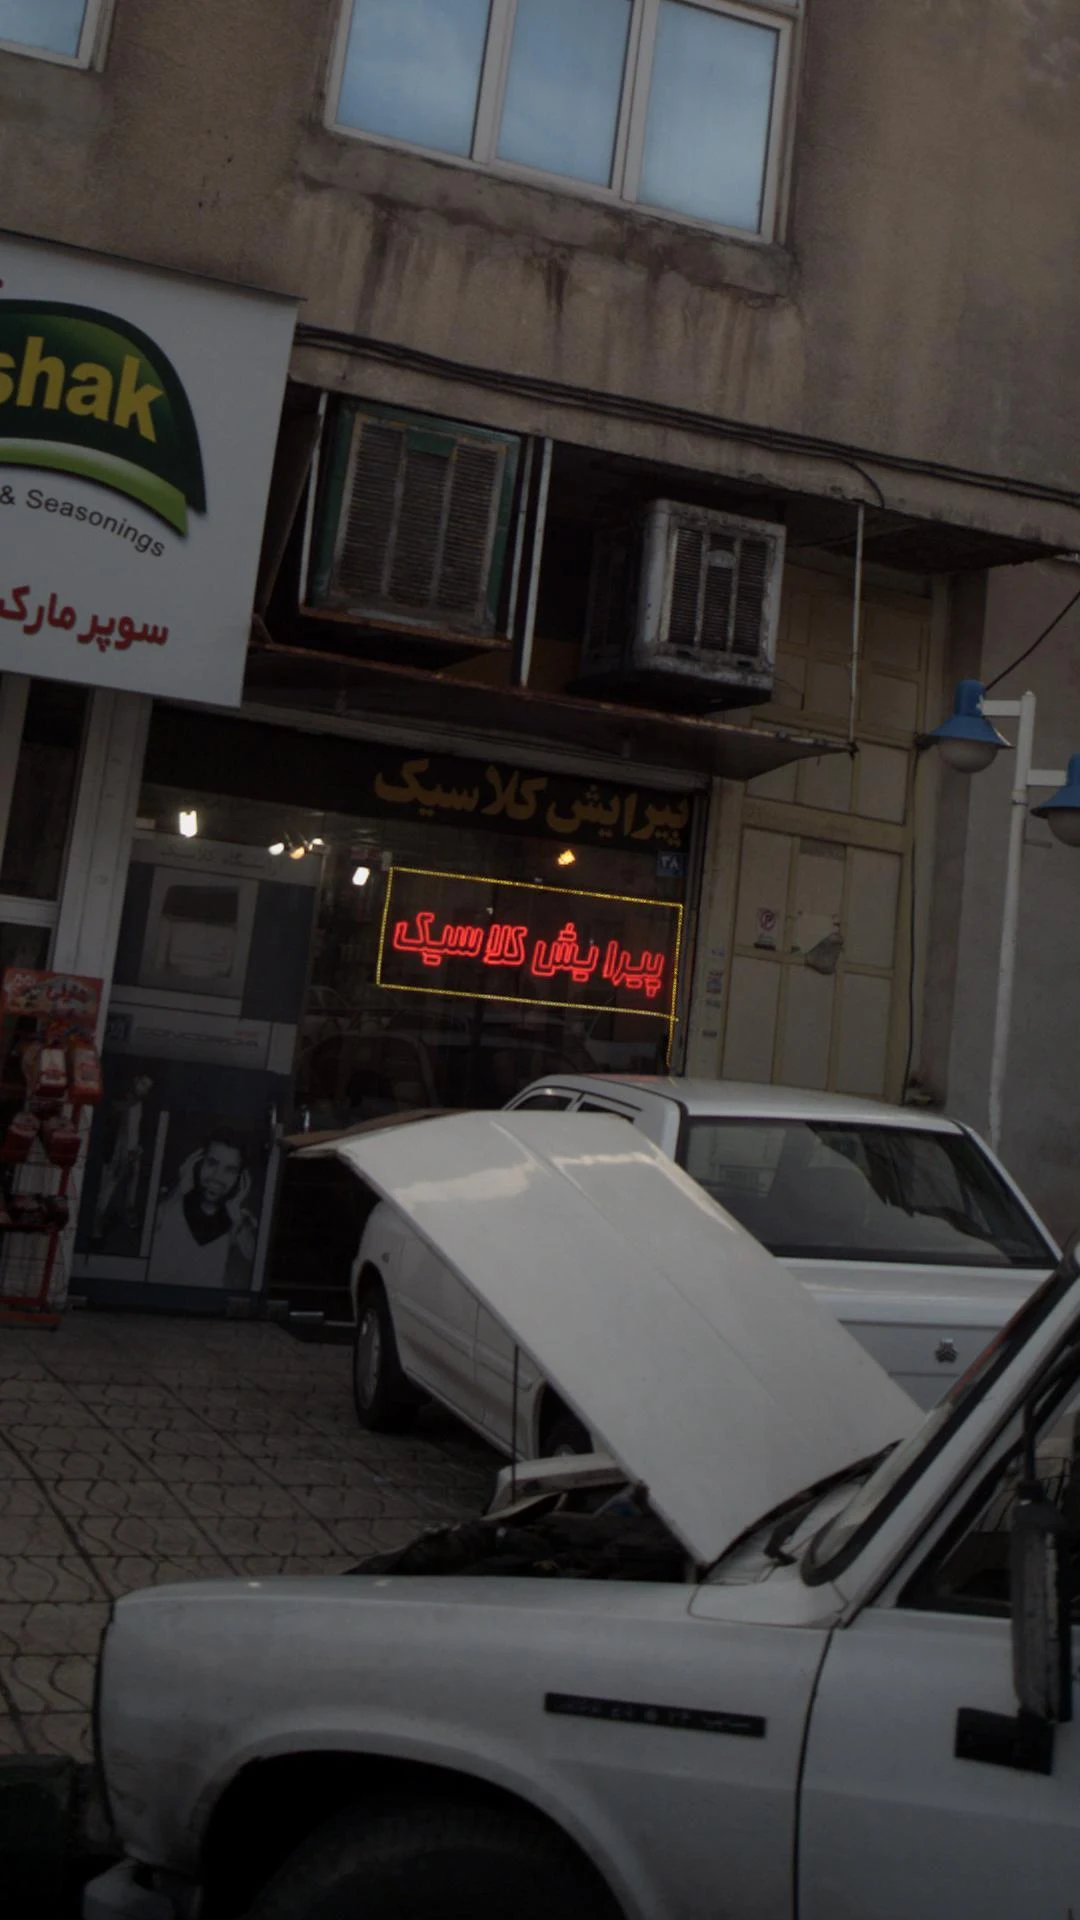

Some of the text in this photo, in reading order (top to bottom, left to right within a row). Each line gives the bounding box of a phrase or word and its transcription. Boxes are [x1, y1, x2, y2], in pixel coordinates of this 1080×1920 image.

[26, 489, 165, 557] Seasonings
[0, 585, 169, 652] سوپر مارک
[373, 757, 689, 847] پیرایش کلاسیک
[391, 911, 667, 1001] پیرایش کلاسیک
